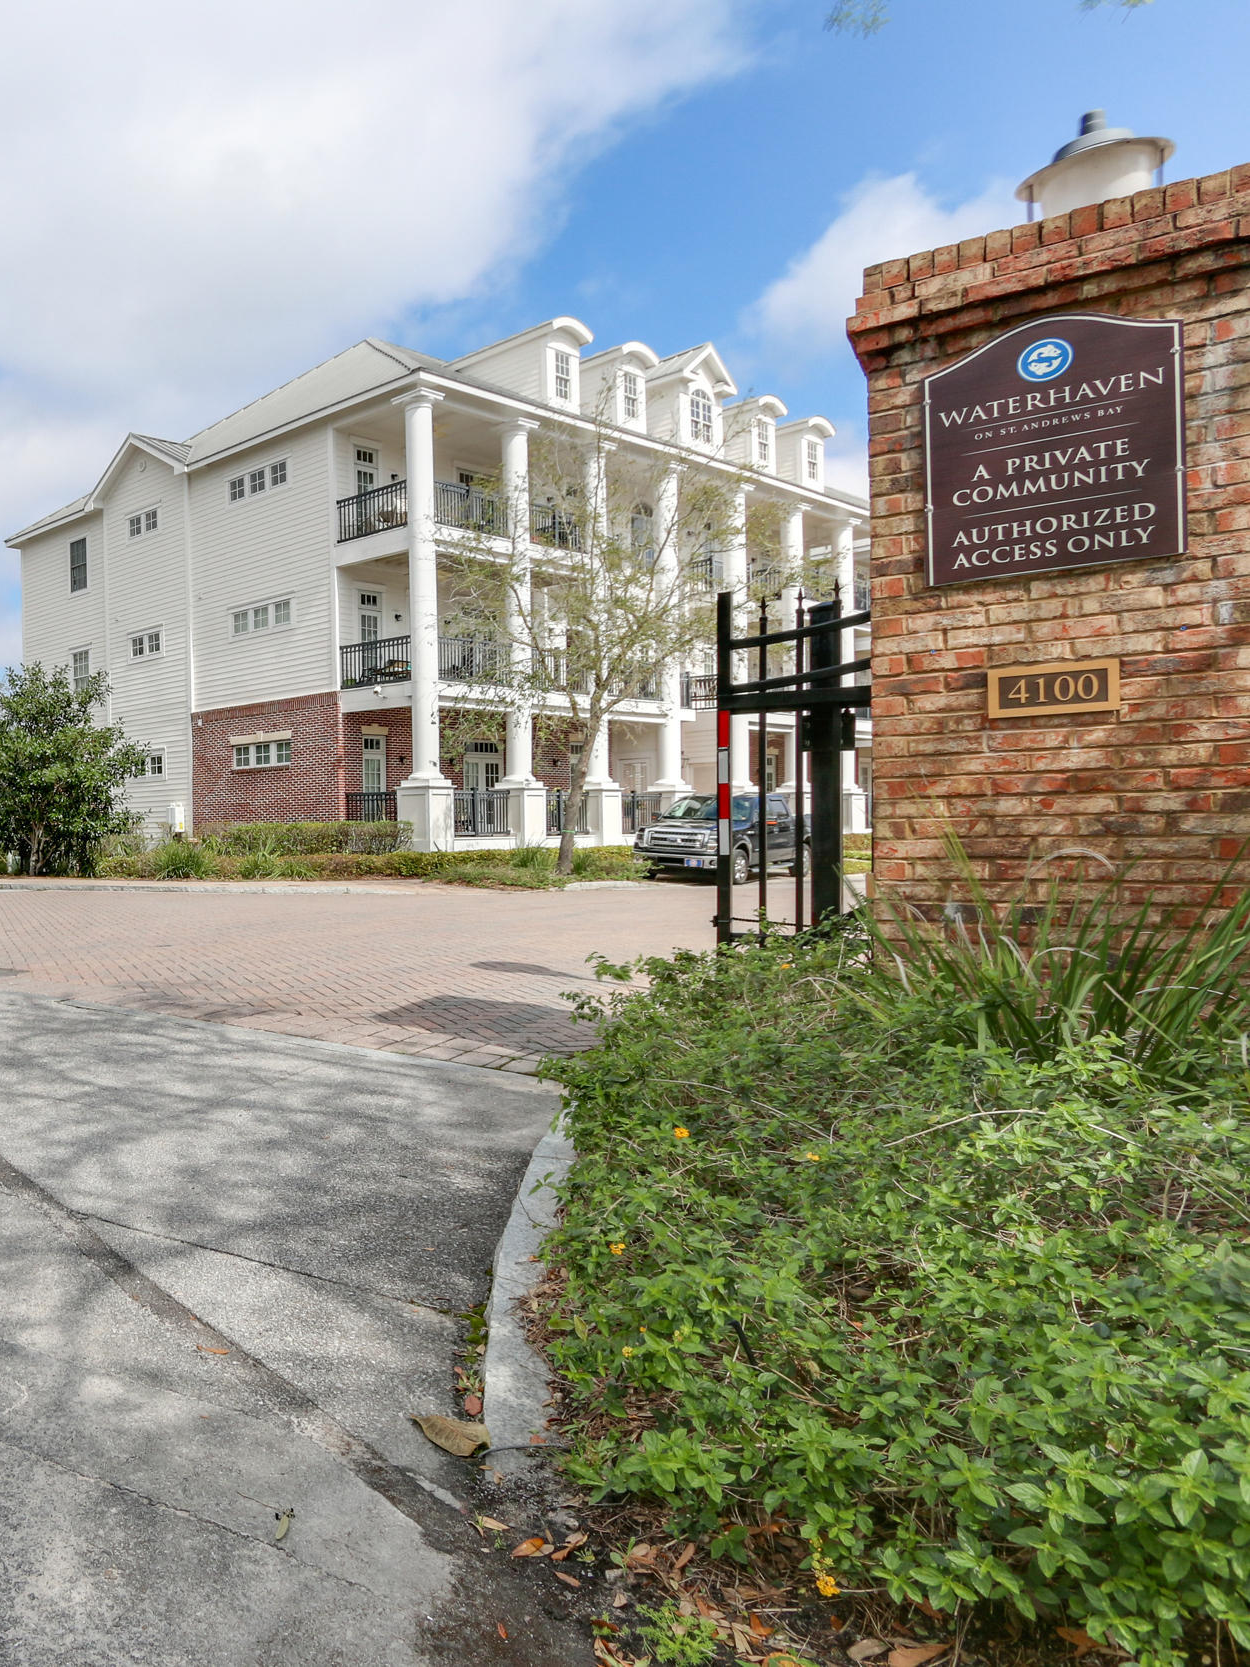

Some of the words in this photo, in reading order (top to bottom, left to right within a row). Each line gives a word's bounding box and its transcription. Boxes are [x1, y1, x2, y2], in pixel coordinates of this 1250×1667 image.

[939, 366, 1165, 428] WATERHAVEN
[974, 430, 993, 441] ON
[1000, 425, 1017, 436] ST.
[1021, 411, 1091, 432] ANDREWS
[1097, 405, 1124, 417] BAY
[952, 458, 1151, 507] COMMUNITY
[971, 464, 992, 482] A
[1006, 438, 1130, 476] PRIVATE
[951, 502, 1156, 548] AUTHORIZED
[951, 539, 1057, 570] ACCESS
[1067, 525, 1156, 553] ONLY
[1007, 673, 1099, 704] 4100
